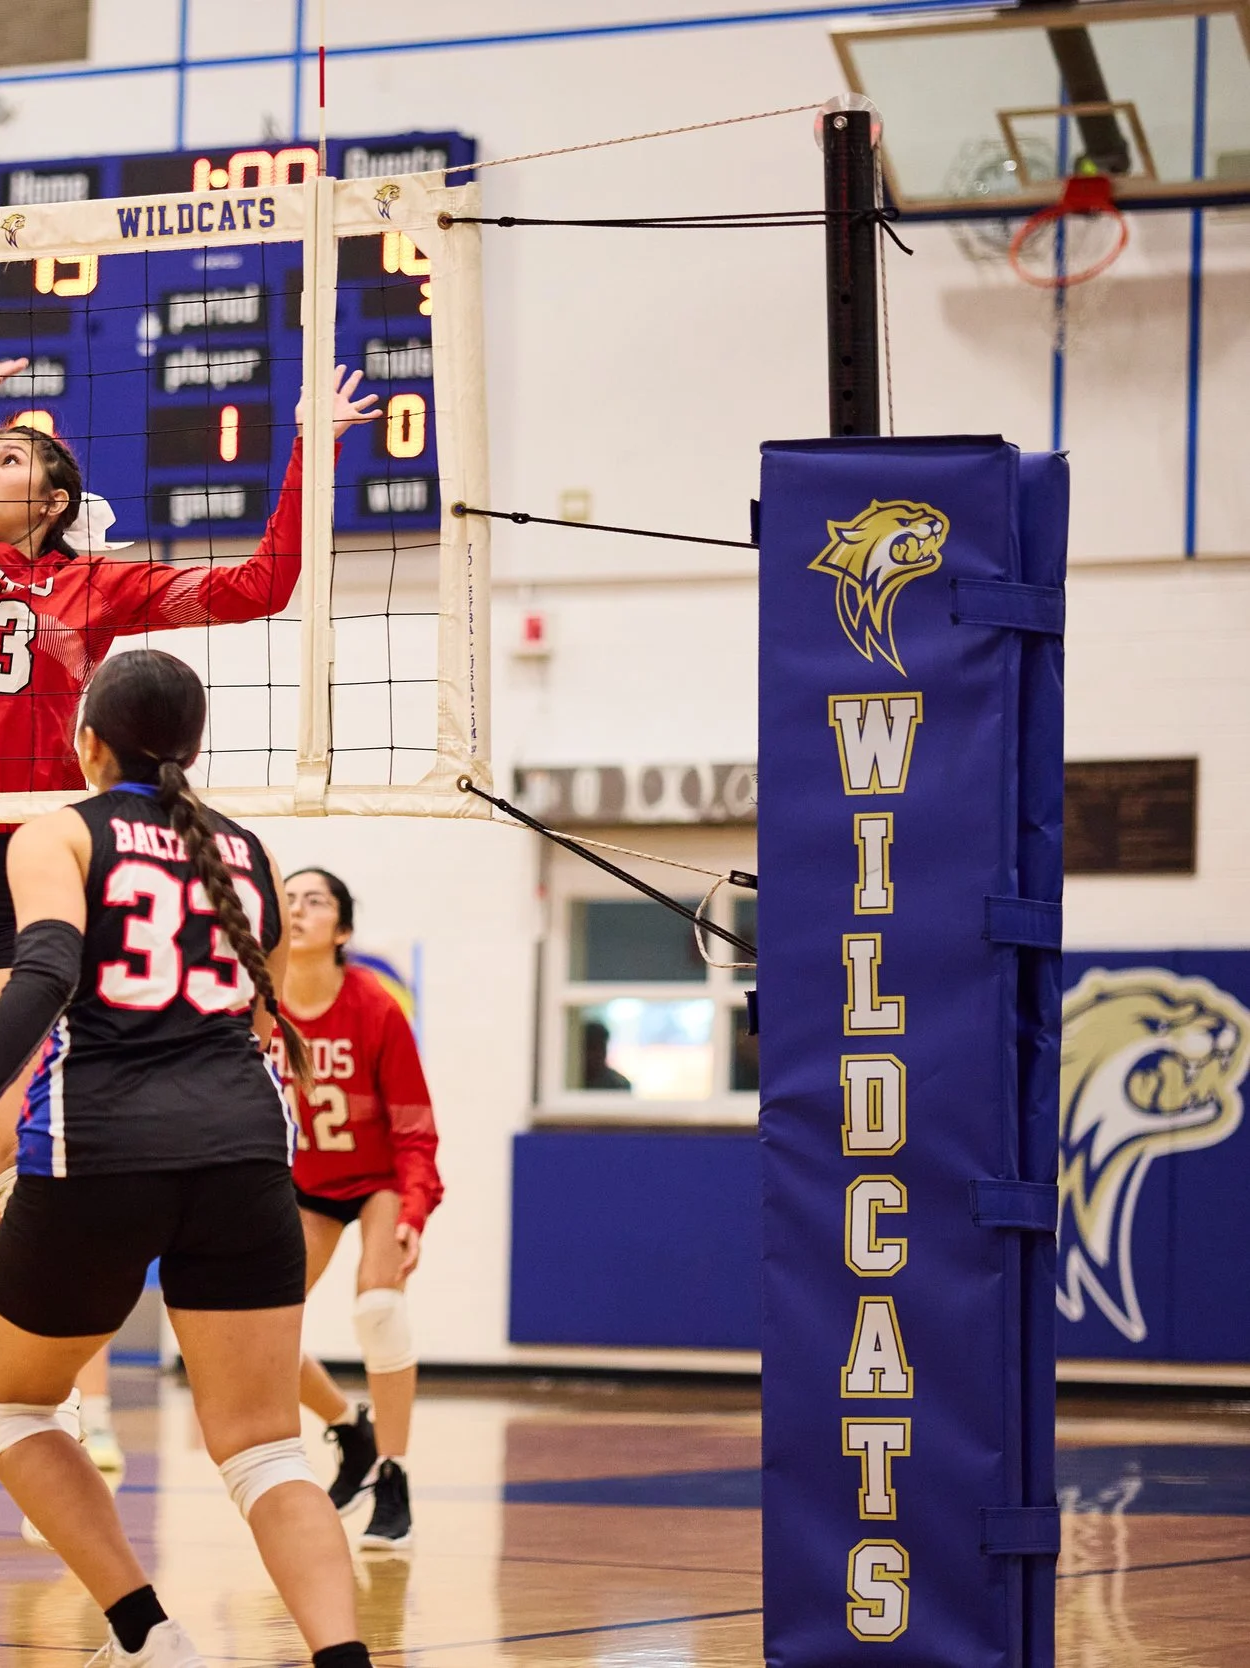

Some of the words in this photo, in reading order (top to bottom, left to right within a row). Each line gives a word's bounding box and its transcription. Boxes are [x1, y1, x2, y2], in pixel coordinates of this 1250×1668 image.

[117, 197, 276, 239] WILDCATS
[386, 392, 426, 460] 0
[96, 857, 265, 1017] 33
[828, 691, 924, 1643] WILDCATS
